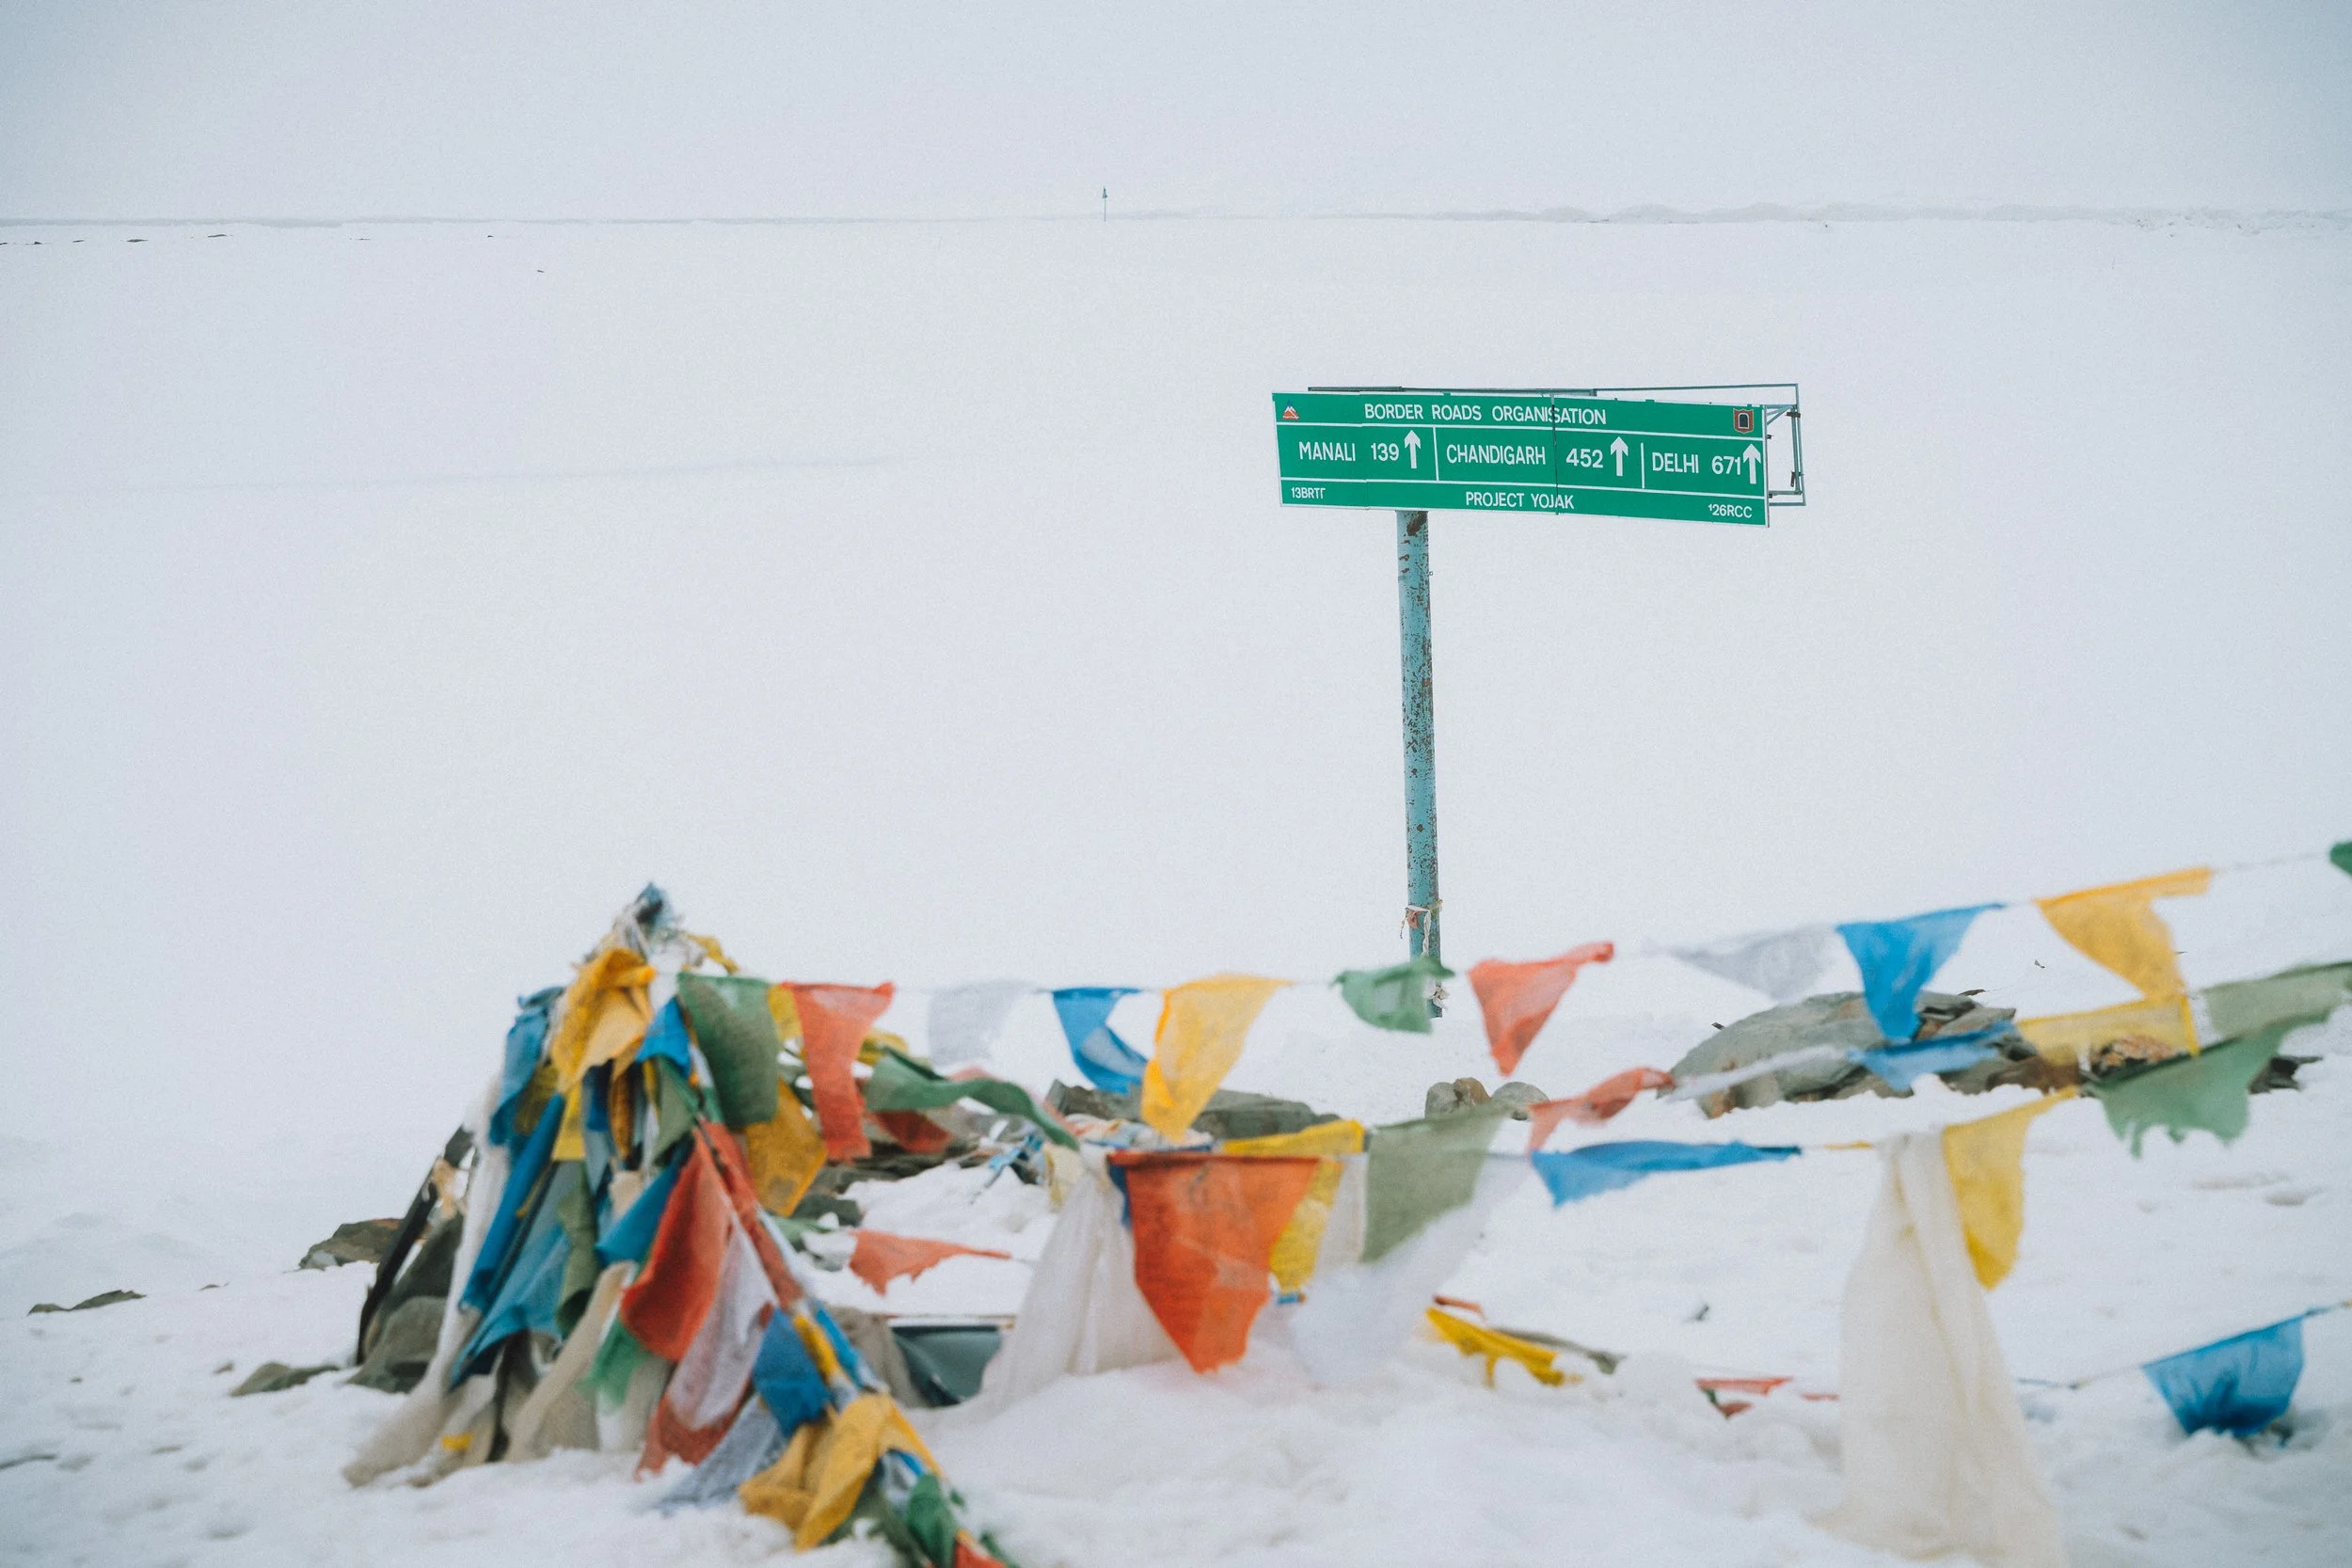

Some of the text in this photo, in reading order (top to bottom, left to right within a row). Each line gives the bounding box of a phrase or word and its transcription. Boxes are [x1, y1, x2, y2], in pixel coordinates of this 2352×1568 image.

[1364, 404, 1607, 425] BORDER ROADS ORGANISATION
[1299, 441, 1399, 462] MANALI 139
[1446, 444, 1603, 468] CHANDIGARH 452
[1652, 451, 1740, 476] DELHI 671
[1466, 491, 1574, 510] PROJECT YOJAK
